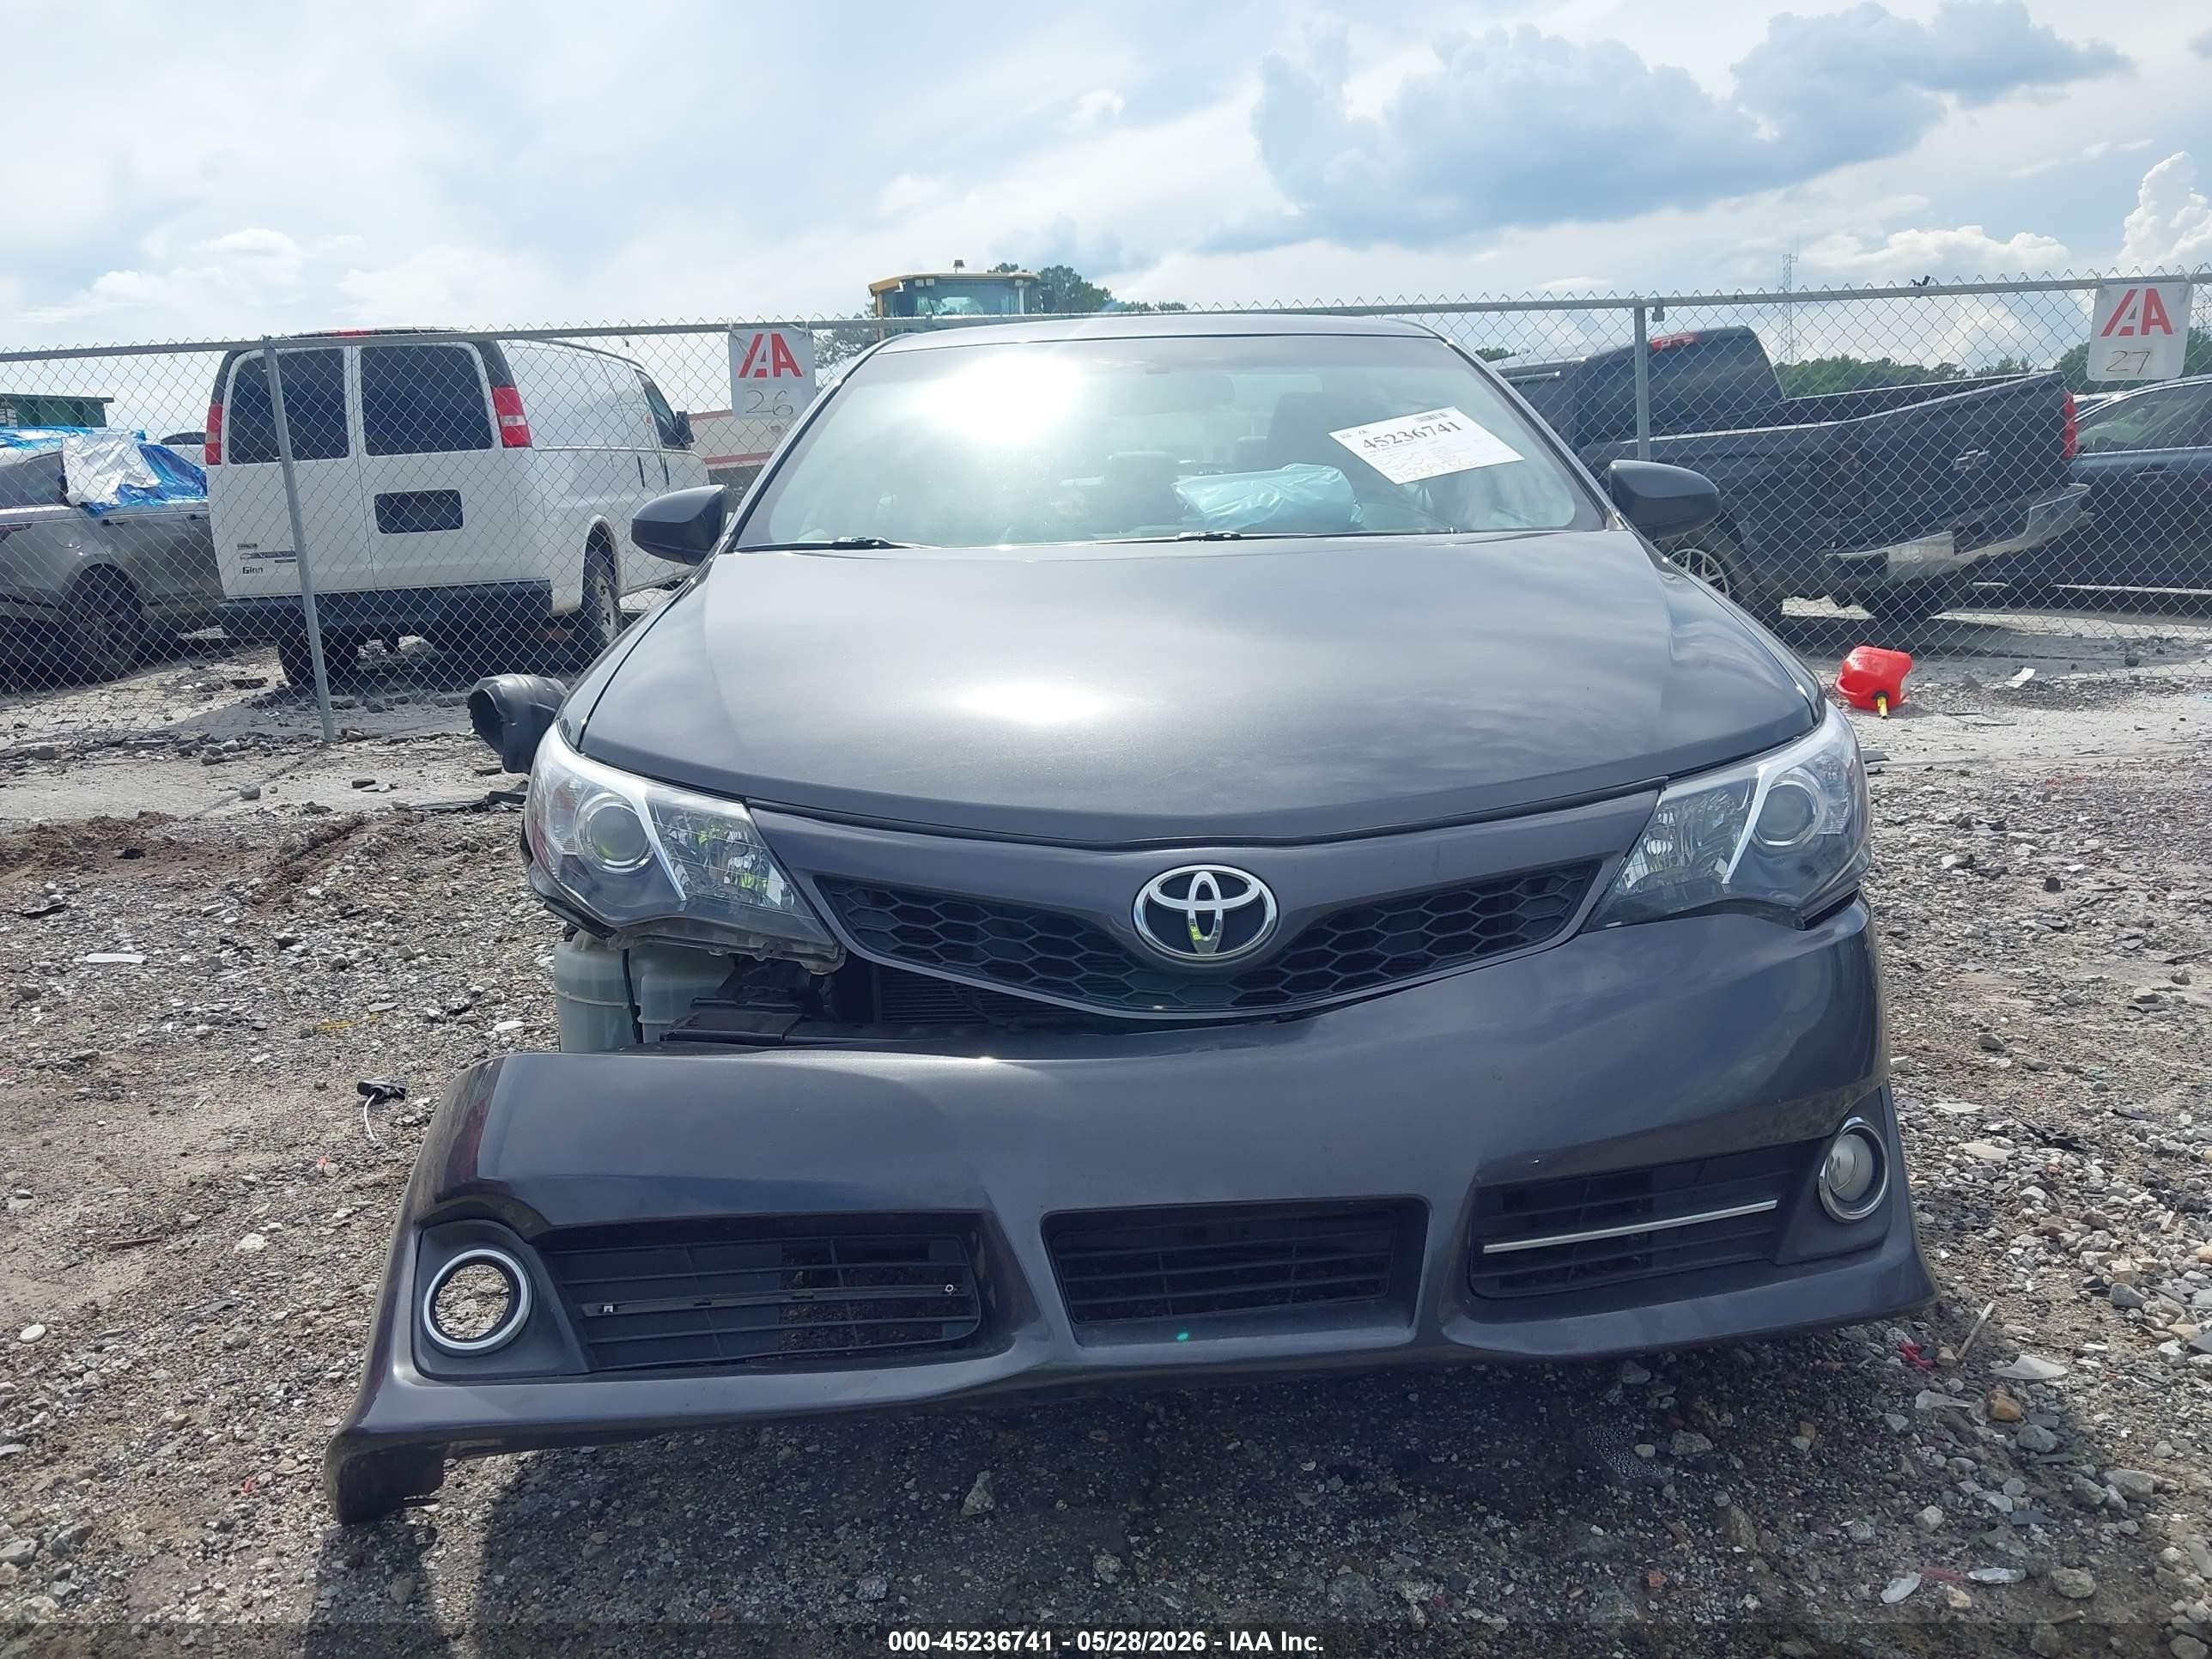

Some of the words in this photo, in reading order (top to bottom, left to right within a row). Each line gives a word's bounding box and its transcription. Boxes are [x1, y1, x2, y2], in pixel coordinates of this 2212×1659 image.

[2106, 350, 2150, 375] 27
[745, 390, 793, 416] 26
[1364, 421, 1463, 447] 45236741
